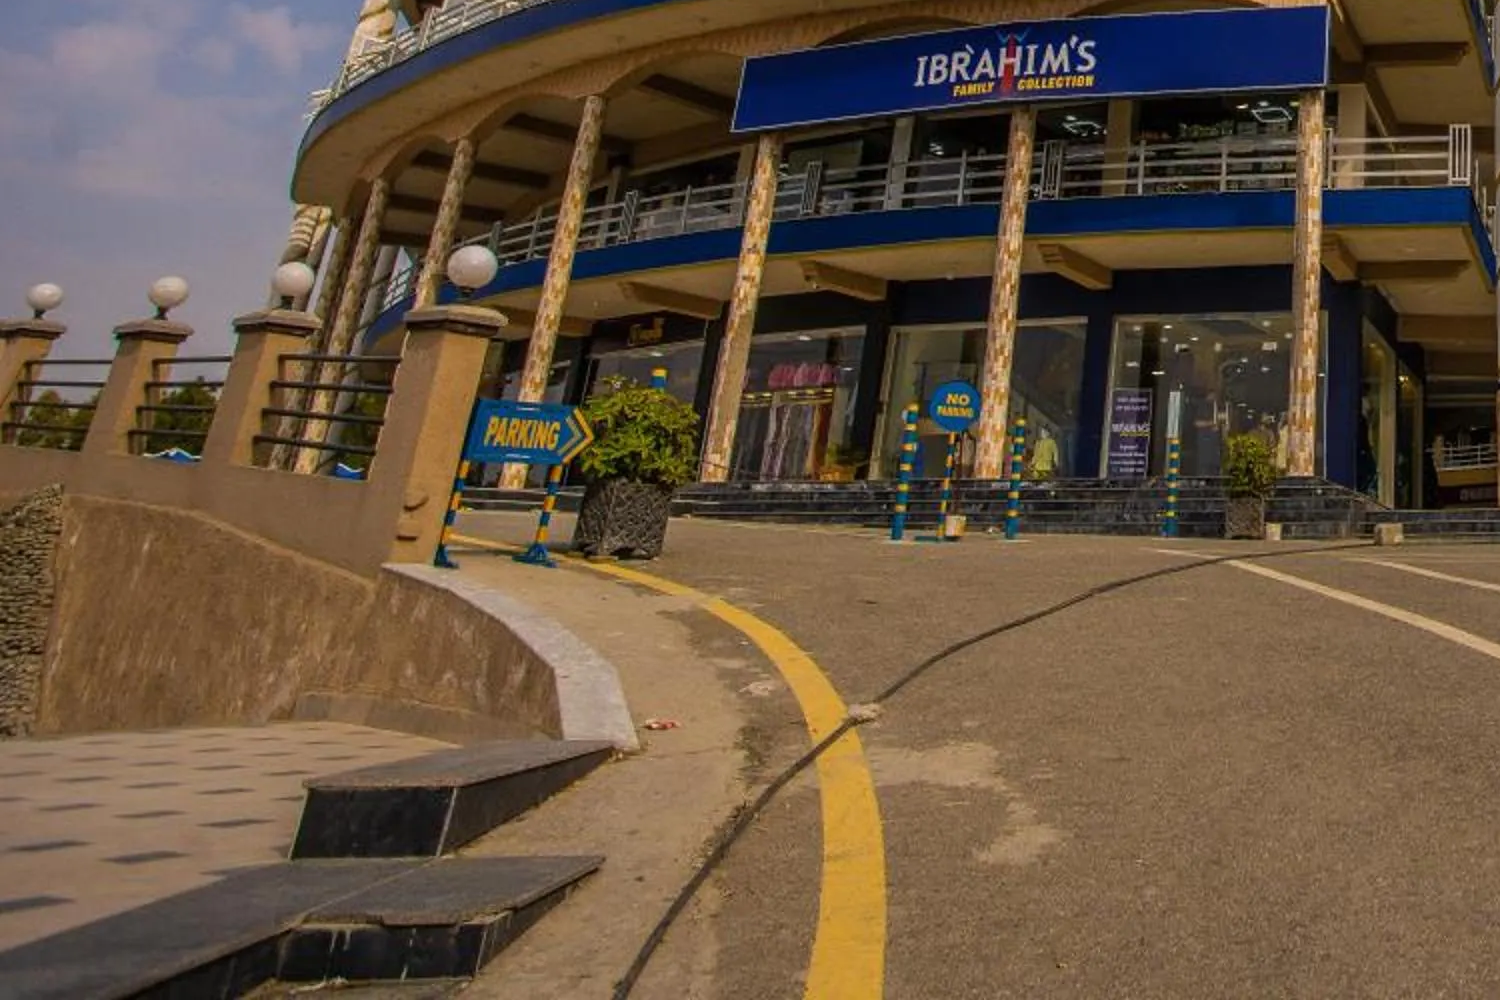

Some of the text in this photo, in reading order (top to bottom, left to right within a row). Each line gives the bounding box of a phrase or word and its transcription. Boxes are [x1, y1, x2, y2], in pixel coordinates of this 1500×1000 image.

[913, 32, 1097, 88] IBRAHIM'S
[953, 75, 1095, 97] FAMILY COLLECTION
[945, 393, 970, 406] NO
[483, 415, 562, 451] PARKING
